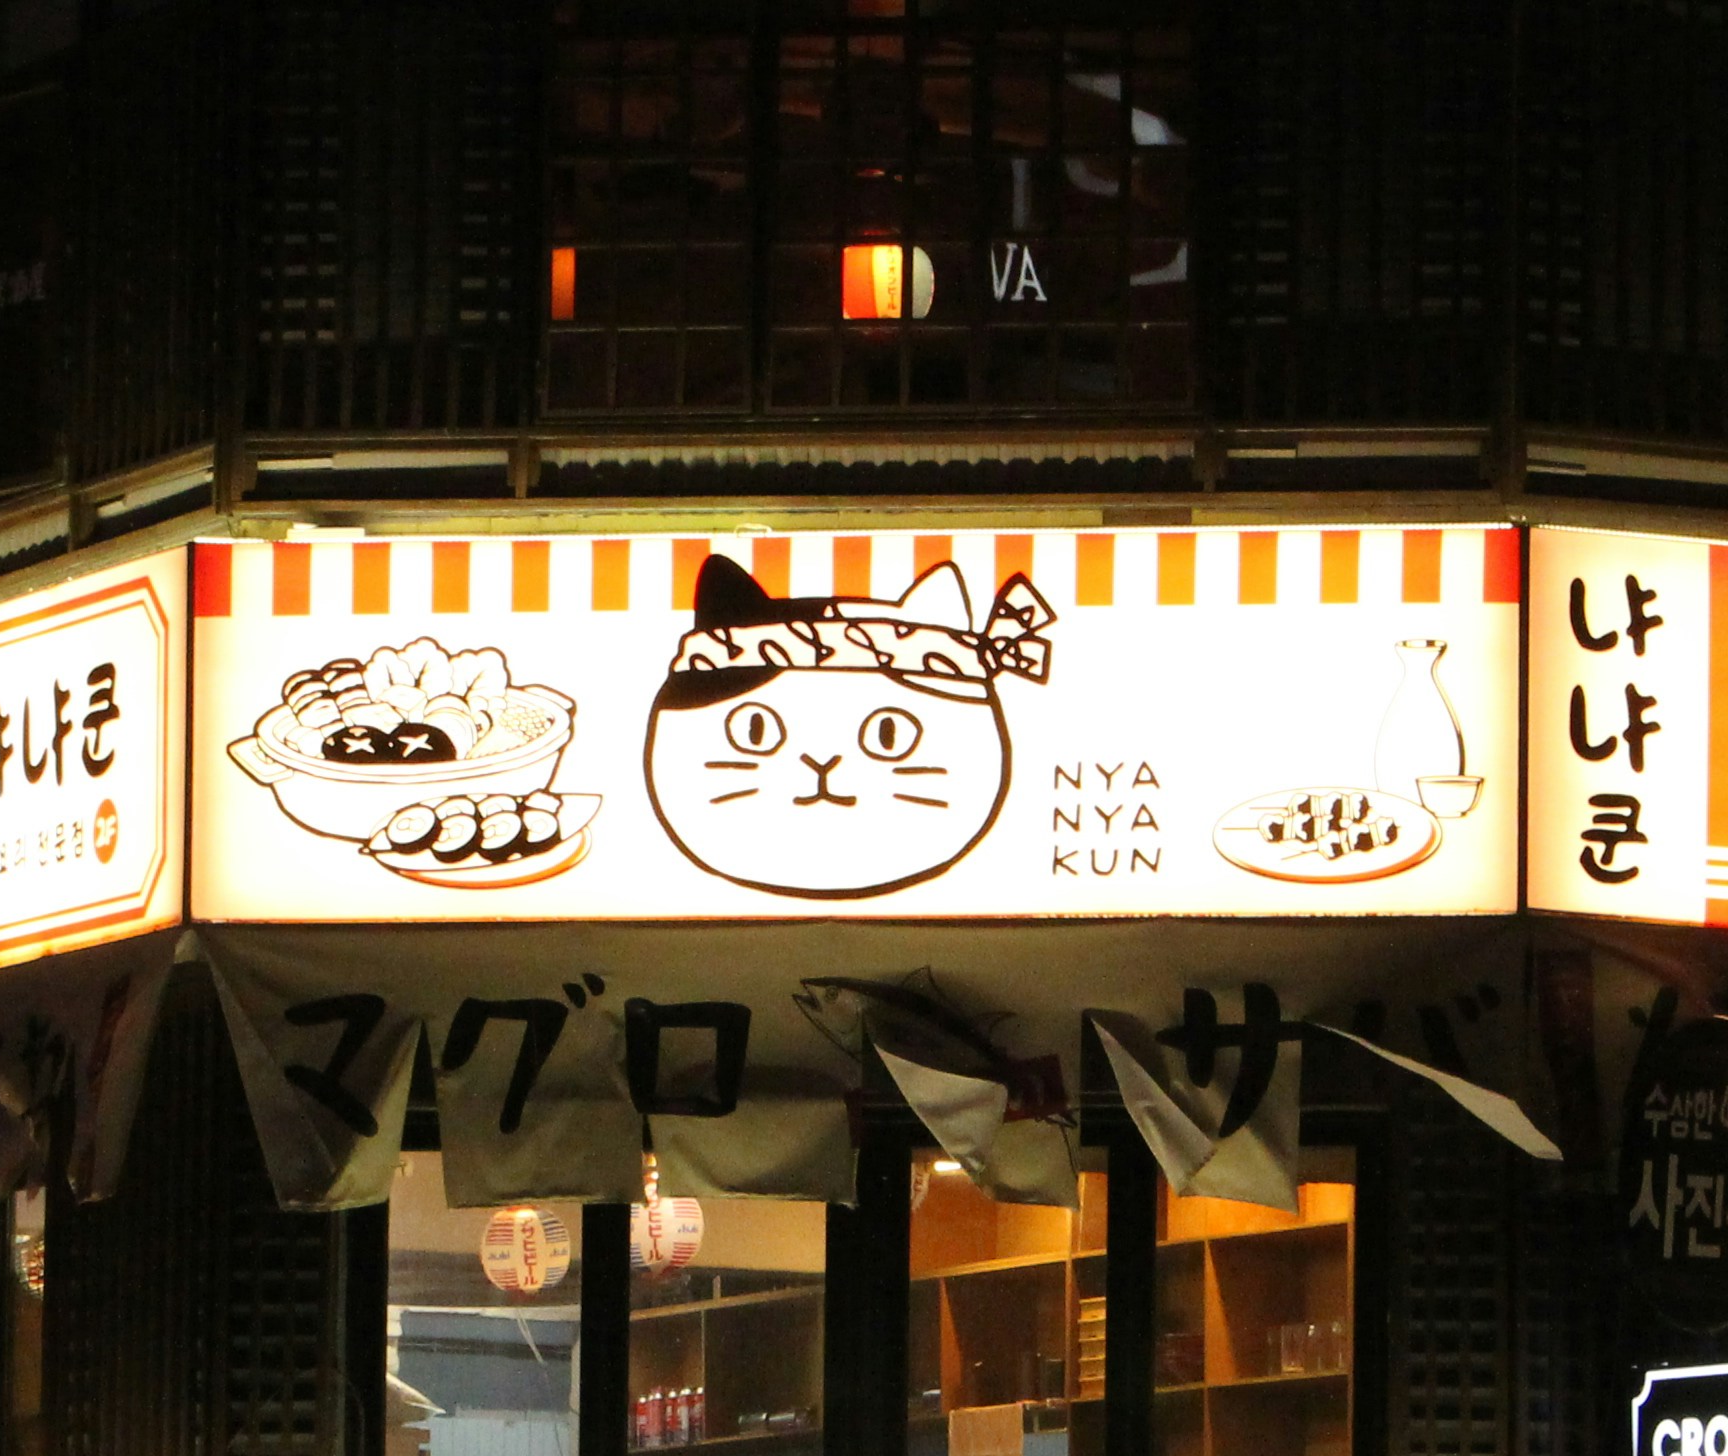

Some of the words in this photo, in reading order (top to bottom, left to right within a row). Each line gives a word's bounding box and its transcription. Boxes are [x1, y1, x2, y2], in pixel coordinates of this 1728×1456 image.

[1569, 574, 1663, 885] 냐냐쿤
[1054, 762, 1160, 790] NYA
[95, 814, 118, 849] 2F
[1053, 804, 1159, 832] NYA
[1052, 848, 1162, 876] KUN
[284, 972, 752, 1137] マグロ
